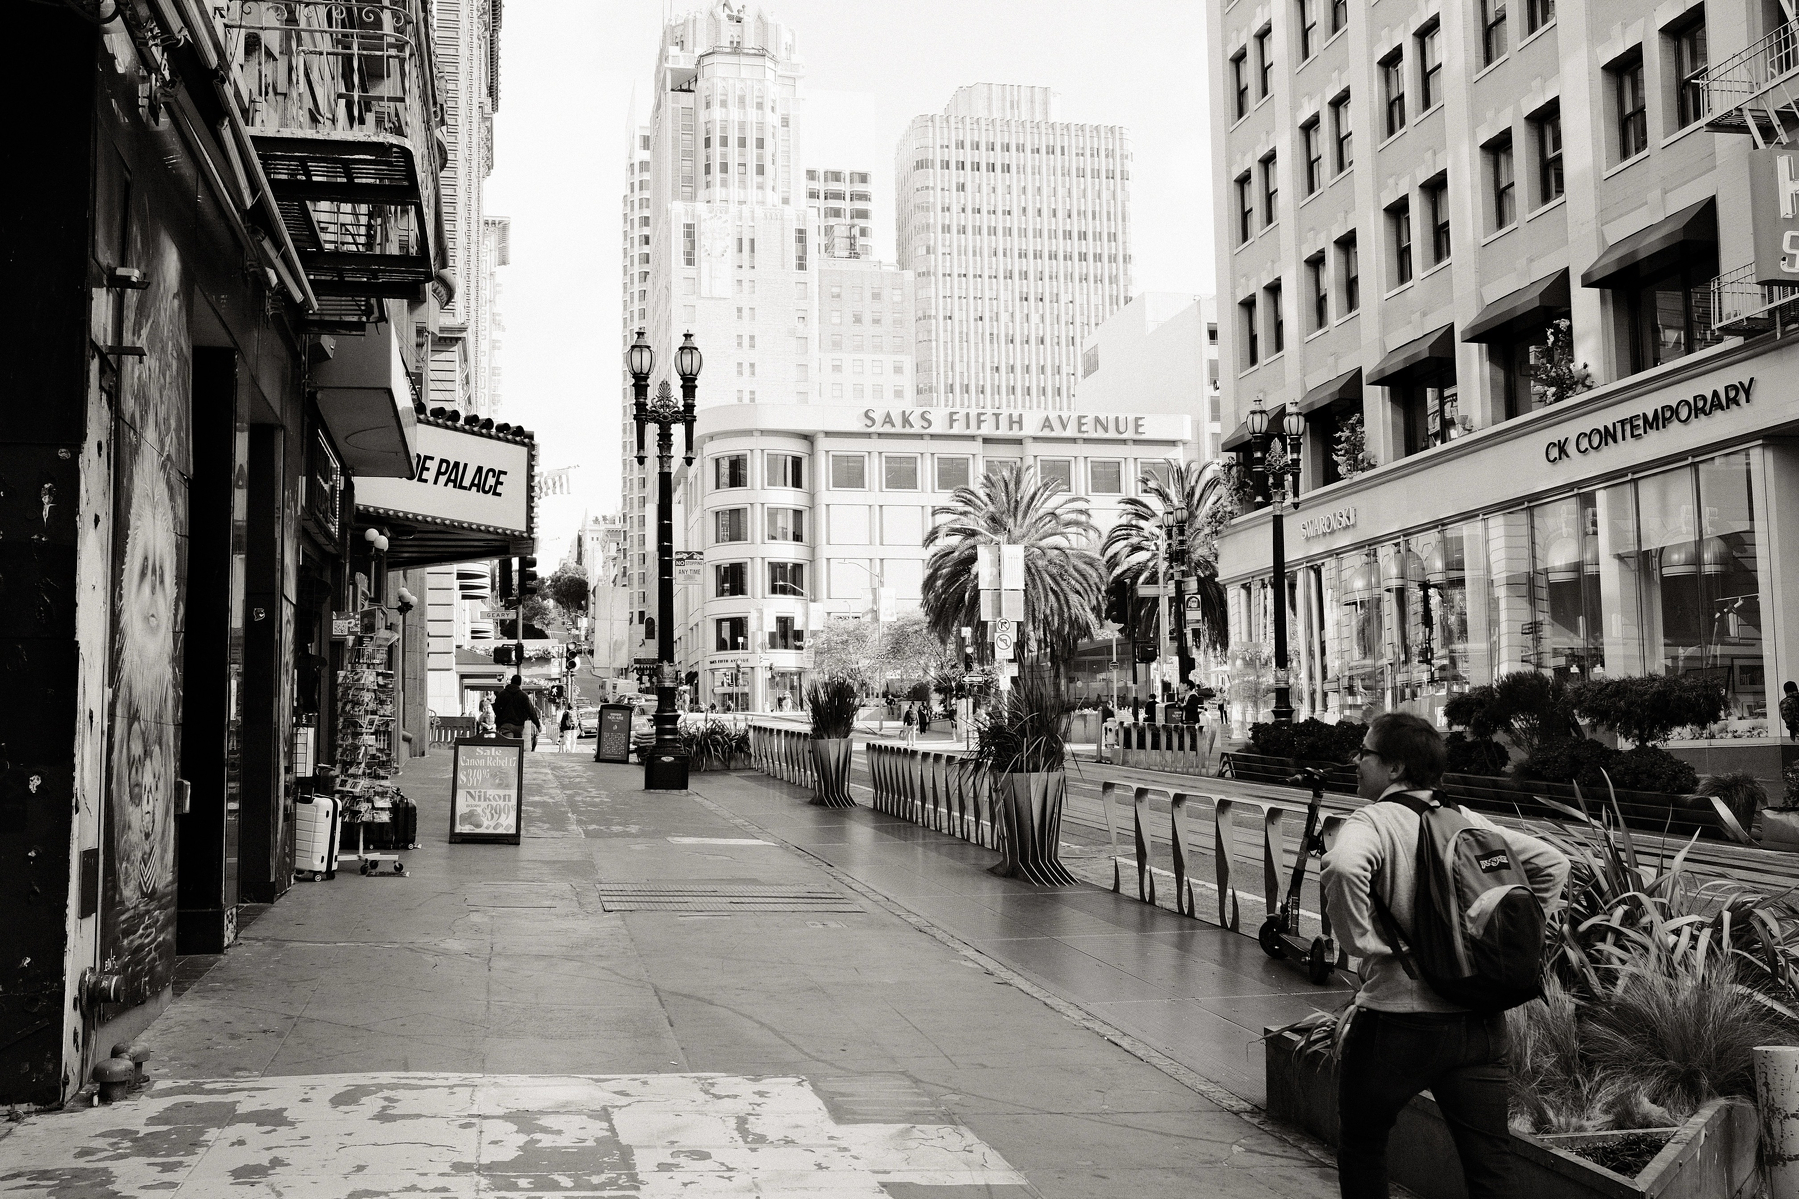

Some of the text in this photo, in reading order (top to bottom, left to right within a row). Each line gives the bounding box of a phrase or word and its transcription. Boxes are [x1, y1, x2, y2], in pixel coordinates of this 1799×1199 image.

[864, 408, 1146, 435] SAKS FIFTH AVENUE
[1545, 376, 1755, 463] CK CONTEMPORARY
[433, 457, 508, 497] PALACE
[1301, 507, 1356, 540] SWAROVSKI
[460, 756, 485, 767] Canon
[487, 756, 508, 767] Rebel
[476, 747, 502, 756] Sale
[465, 790, 512, 803] Nikon
